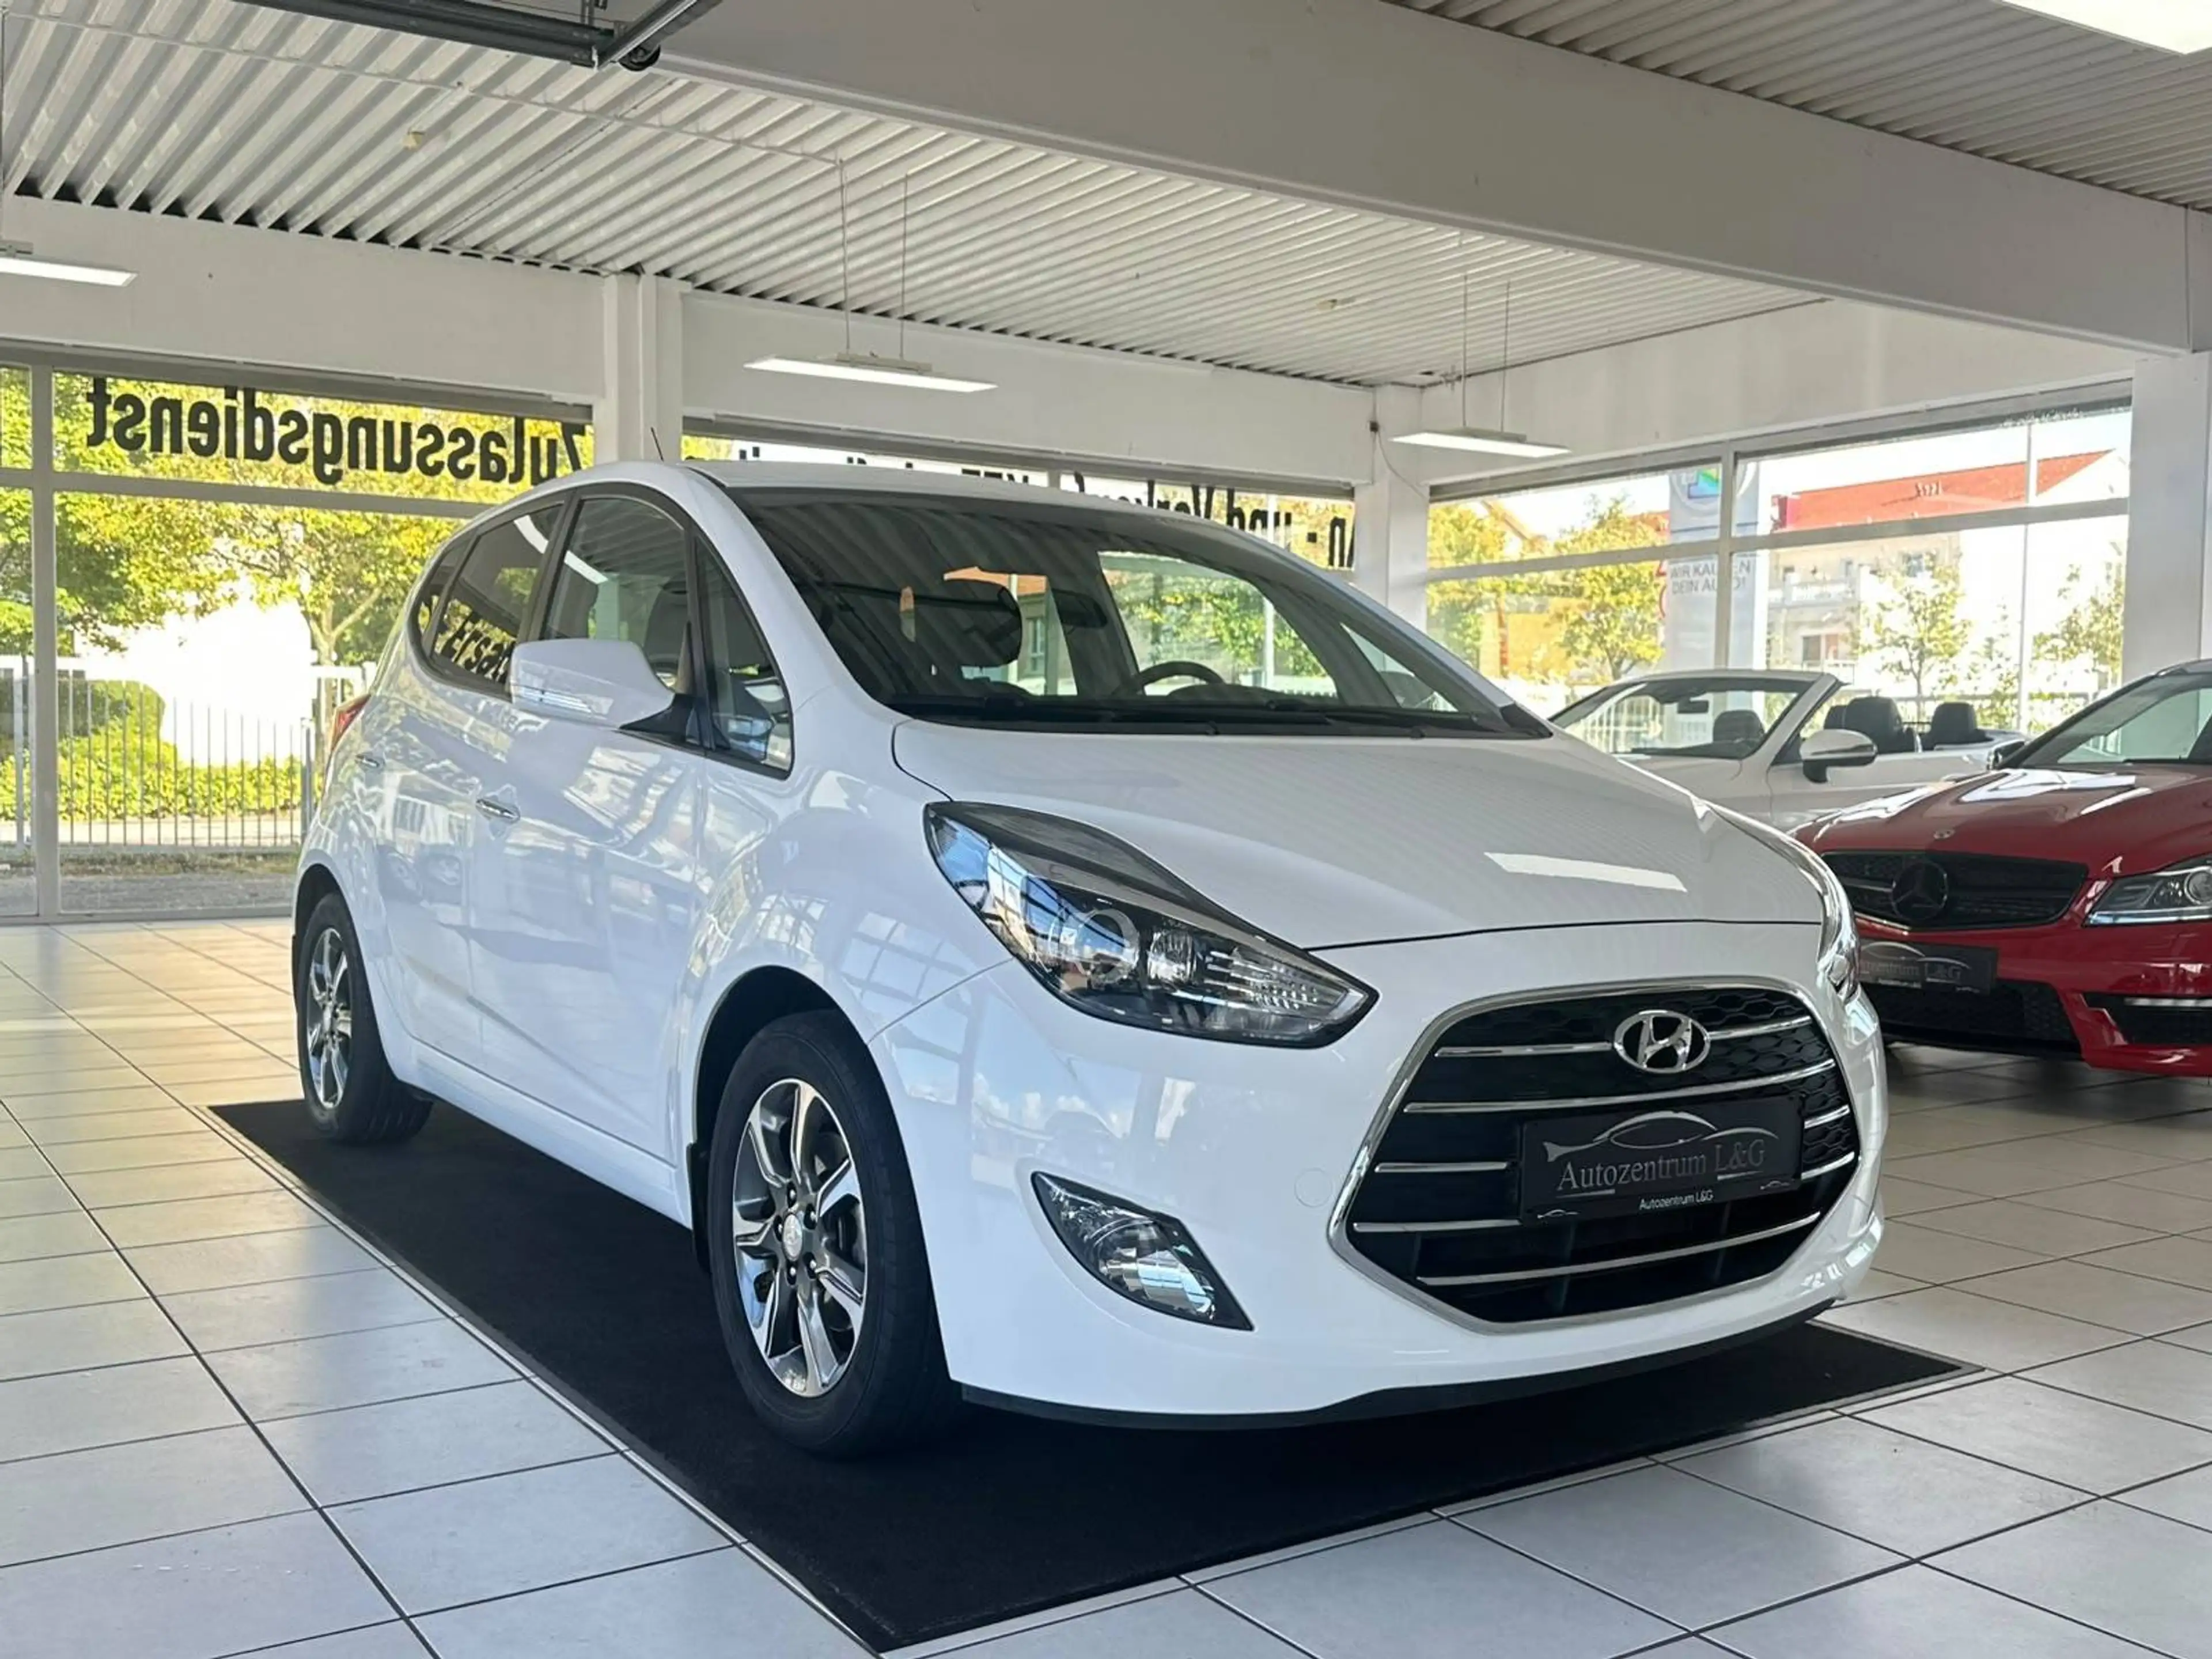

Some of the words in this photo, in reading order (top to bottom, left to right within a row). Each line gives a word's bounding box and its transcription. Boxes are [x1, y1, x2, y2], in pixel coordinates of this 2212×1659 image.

[1557, 1154, 1707, 1191] Autozentrum
[1714, 1139, 1765, 1172] L&G
[1639, 1194, 1694, 1210] Autozentrum
[1696, 1189, 1714, 1203] L&G
